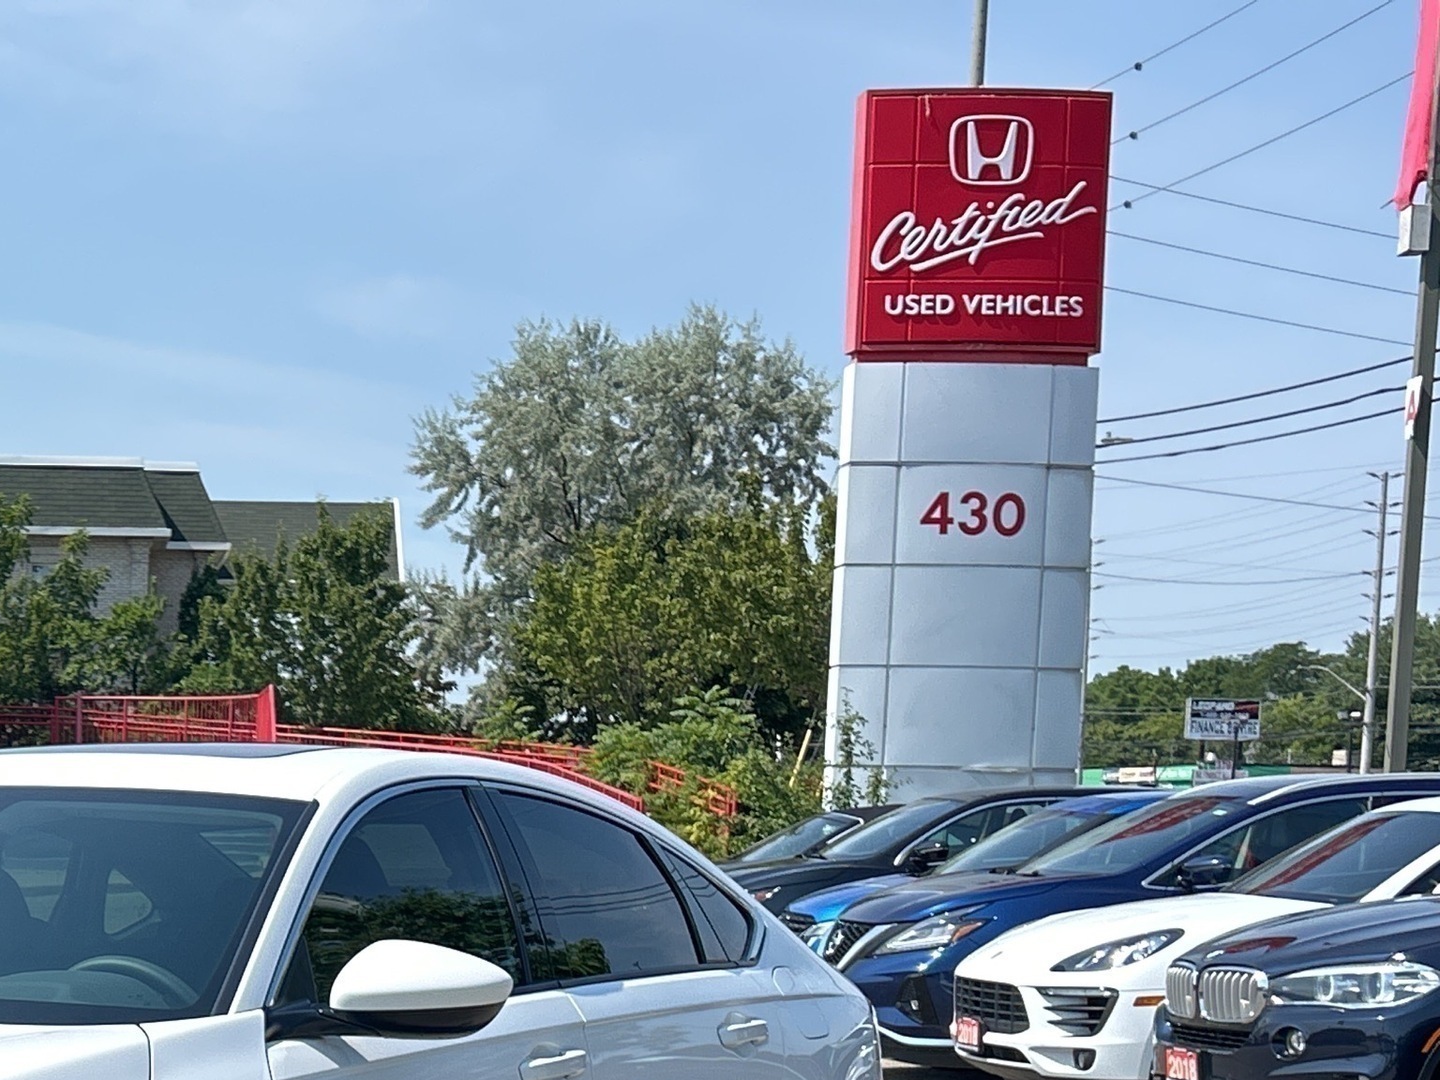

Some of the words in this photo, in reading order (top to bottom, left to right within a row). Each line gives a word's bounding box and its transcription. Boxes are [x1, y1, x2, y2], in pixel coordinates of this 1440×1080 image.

[871, 180, 1098, 273] Certified
[884, 294, 954, 316] USED
[962, 294, 1084, 318] VEHICLES
[920, 492, 1026, 537] 430
[1190, 720, 1225, 735] FINANCE
